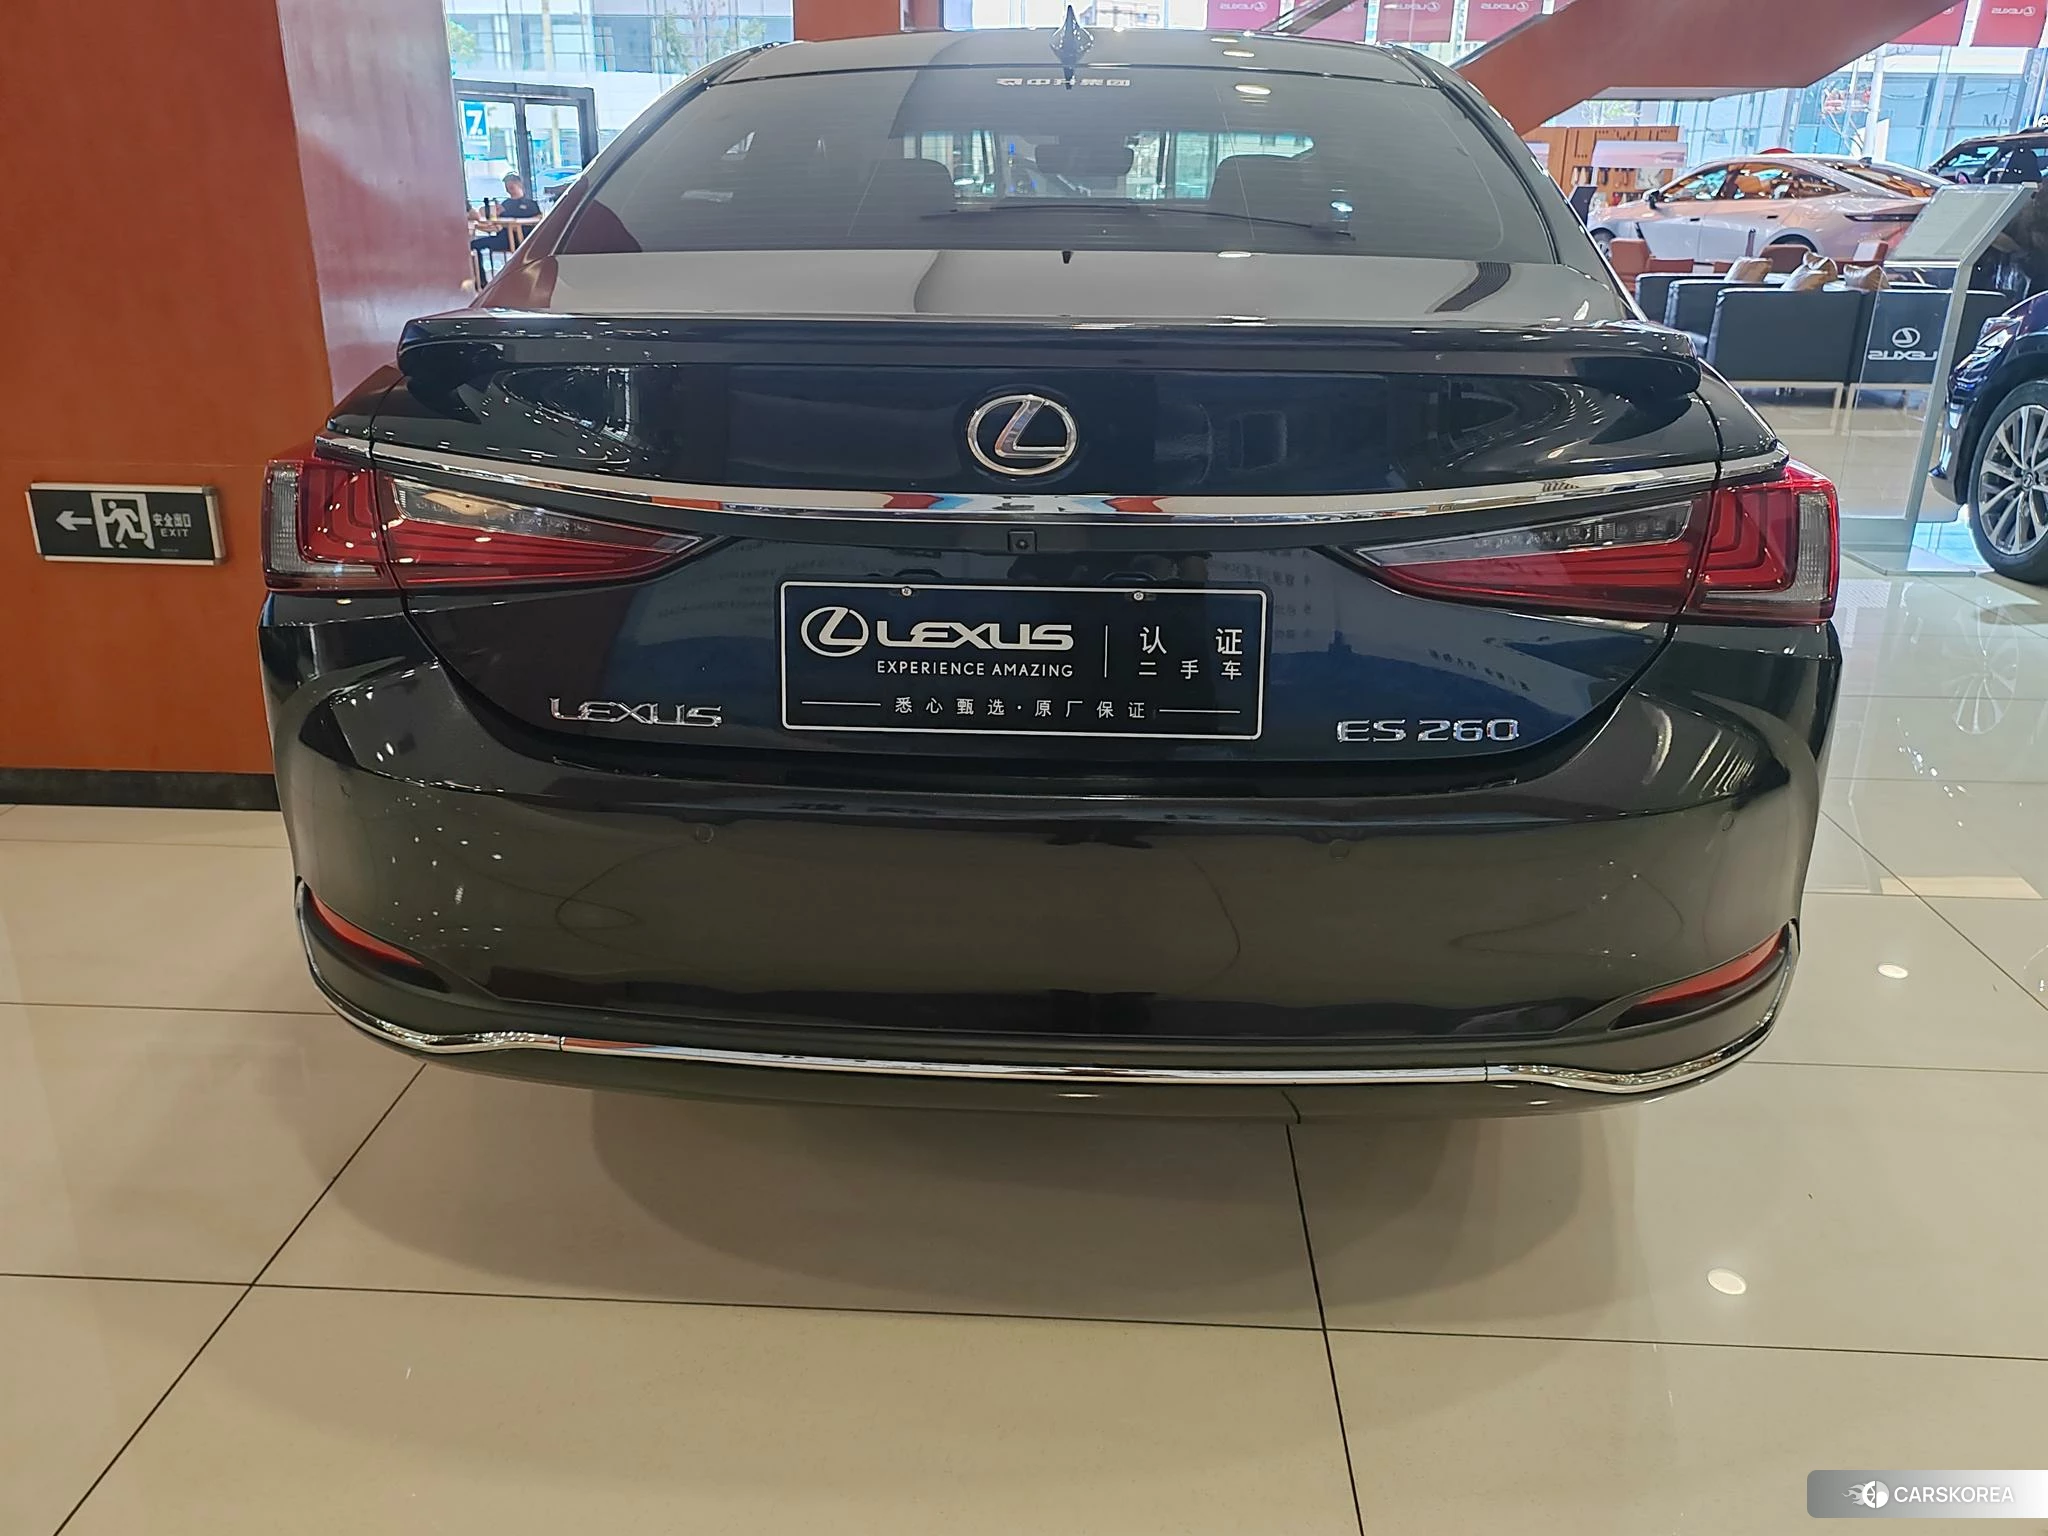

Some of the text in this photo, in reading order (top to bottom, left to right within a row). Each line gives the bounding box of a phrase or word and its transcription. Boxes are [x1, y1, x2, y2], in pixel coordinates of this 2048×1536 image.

[160, 528, 189, 537] EXIT
[876, 620, 1074, 650] LEXUS
[877, 660, 1073, 678] EXPERIENCE AMAZING
[549, 697, 723, 728] LEXUS
[1336, 718, 1520, 743] ES 260
